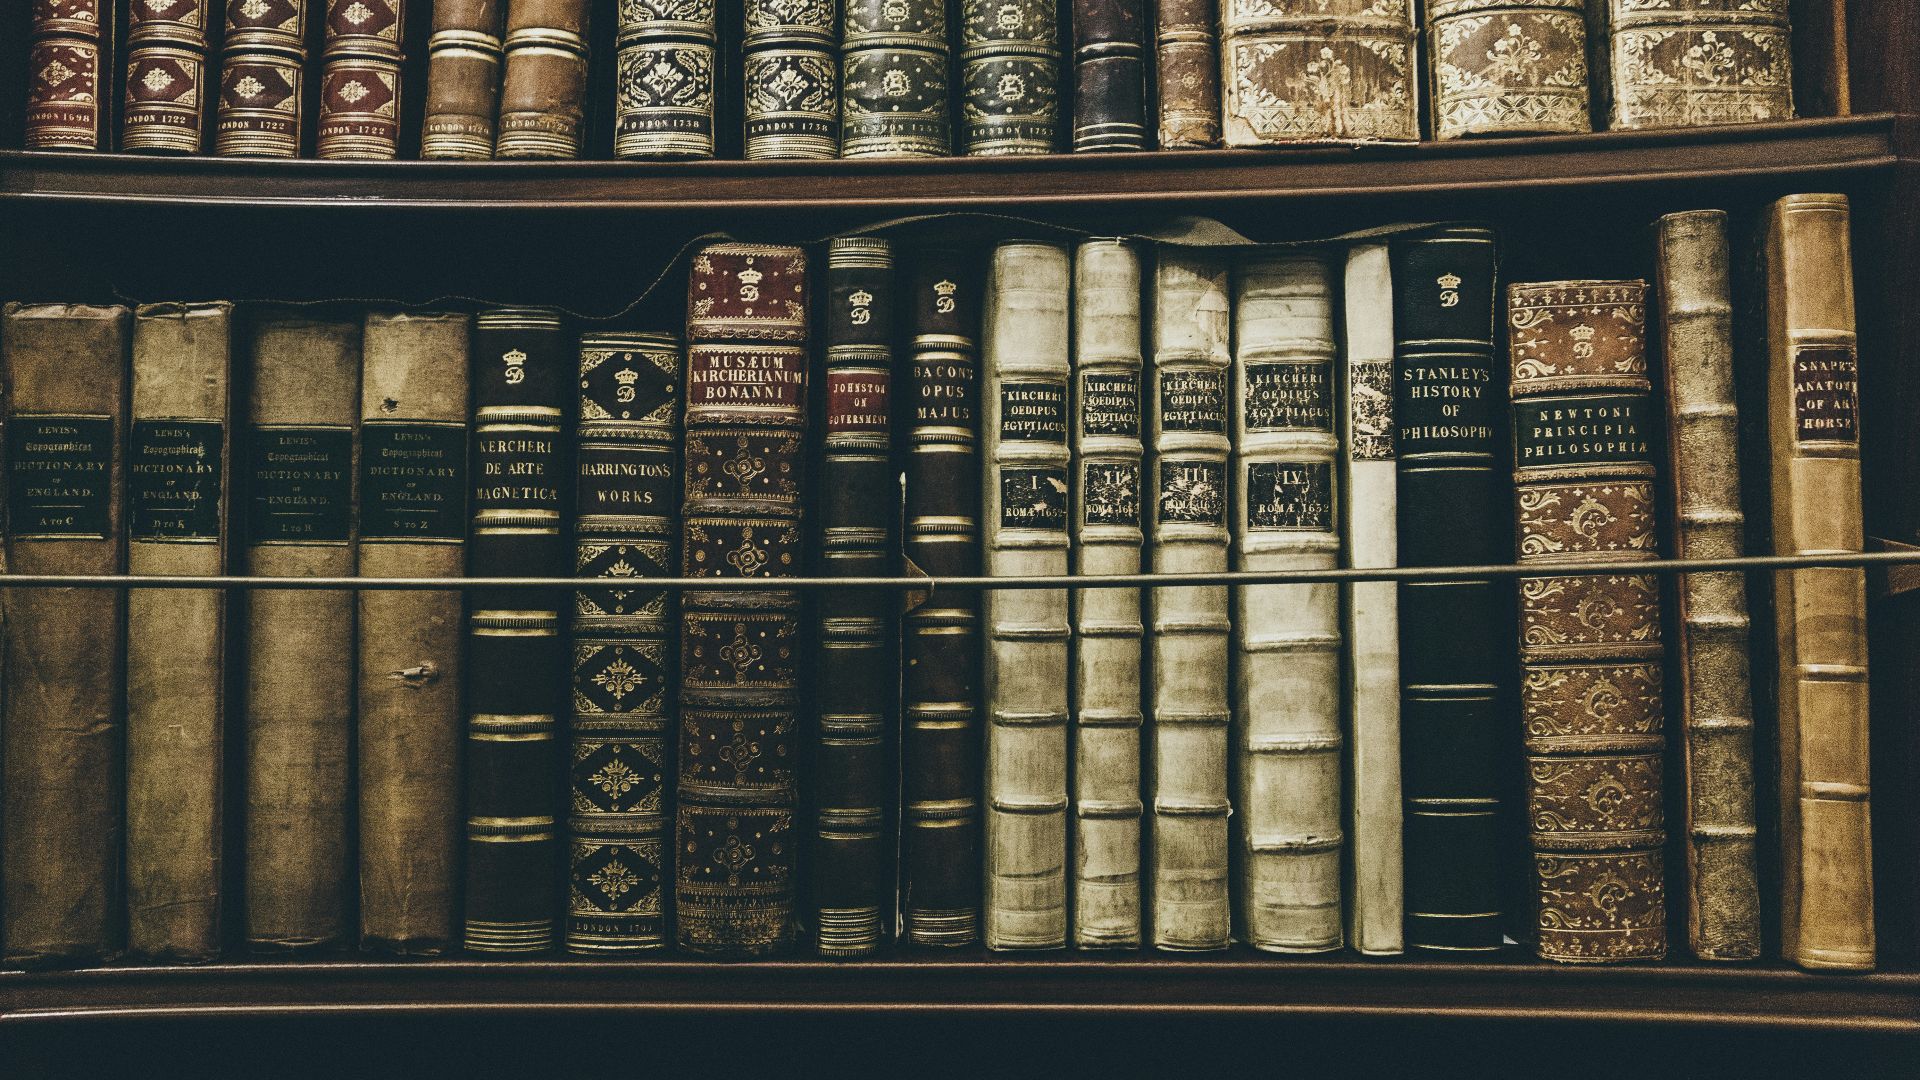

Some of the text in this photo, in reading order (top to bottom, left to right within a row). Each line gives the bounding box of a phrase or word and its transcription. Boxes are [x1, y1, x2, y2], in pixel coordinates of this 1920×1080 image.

[27, 112, 90, 123] ONDON 1698
[124, 114, 186, 125] ONDON 1722
[259, 121, 285, 130] 1722
[429, 124, 464, 132] LONDON
[505, 119, 541, 129] LONDON
[624, 119, 700, 130] LONDON 1738
[751, 122, 795, 133] LONDON
[853, 123, 904, 134] LONDON
[357, 125, 385, 135] 1722
[972, 126, 1020, 137] LONDON
[709, 355, 784, 369] MUSÆUM
[693, 369, 802, 384] KIRCHERIANUM
[1256, 374, 1323, 384] KIRCHERI
[1404, 367, 1490, 382] STANLEY'S
[706, 385, 783, 399] BONANNI
[833, 382, 885, 394] JOHNSTON
[922, 384, 964, 398] OPUS
[1087, 382, 1137, 394] KIRCHERI
[1411, 385, 1482, 399] HISTORY
[1007, 390, 1061, 402] KIRCHERI
[1170, 395, 1218, 405] OEDIPUS
[1261, 390, 1319, 400] OEDIPUS
[854, 397, 867, 407] ON
[1092, 396, 1135, 407] OEDIPUS
[1806, 399, 1825, 410] OF
[917, 406, 969, 419] MAJUS
[1011, 405, 1057, 416] OEDIPUS
[1250, 407, 1330, 418] ÆGYPTIACUS
[1442, 404, 1461, 417] OF
[1540, 407, 1630, 421] NEWTONI
[828, 414, 887, 425] GOVERNMENT
[1803, 418, 1851, 429] HORSE
[1002, 421, 1066, 432] ÆGYPTIACUS
[1533, 424, 1636, 438] PRINCIPIA
[1401, 425, 1493, 440] PHILOSOPHY
[15, 461, 105, 471] DICTIONARY
[133, 464, 214, 473] DICTIONARY
[370, 466, 455, 477] DICTIONARY
[485, 462, 544, 475] DE ARTE
[581, 463, 671, 478] HARRINGTON'S
[257, 471, 341, 480] DICTIONARY
[1105, 470, 1121, 485] II
[1184, 467, 1208, 482] III
[1031, 475, 1038, 490] I
[598, 490, 653, 503] WORKS
[1302, 503, 1329, 513] 1652
[65, 517, 74, 525] C
[420, 520, 428, 529] Z
[576, 922, 619, 932] LONDON
